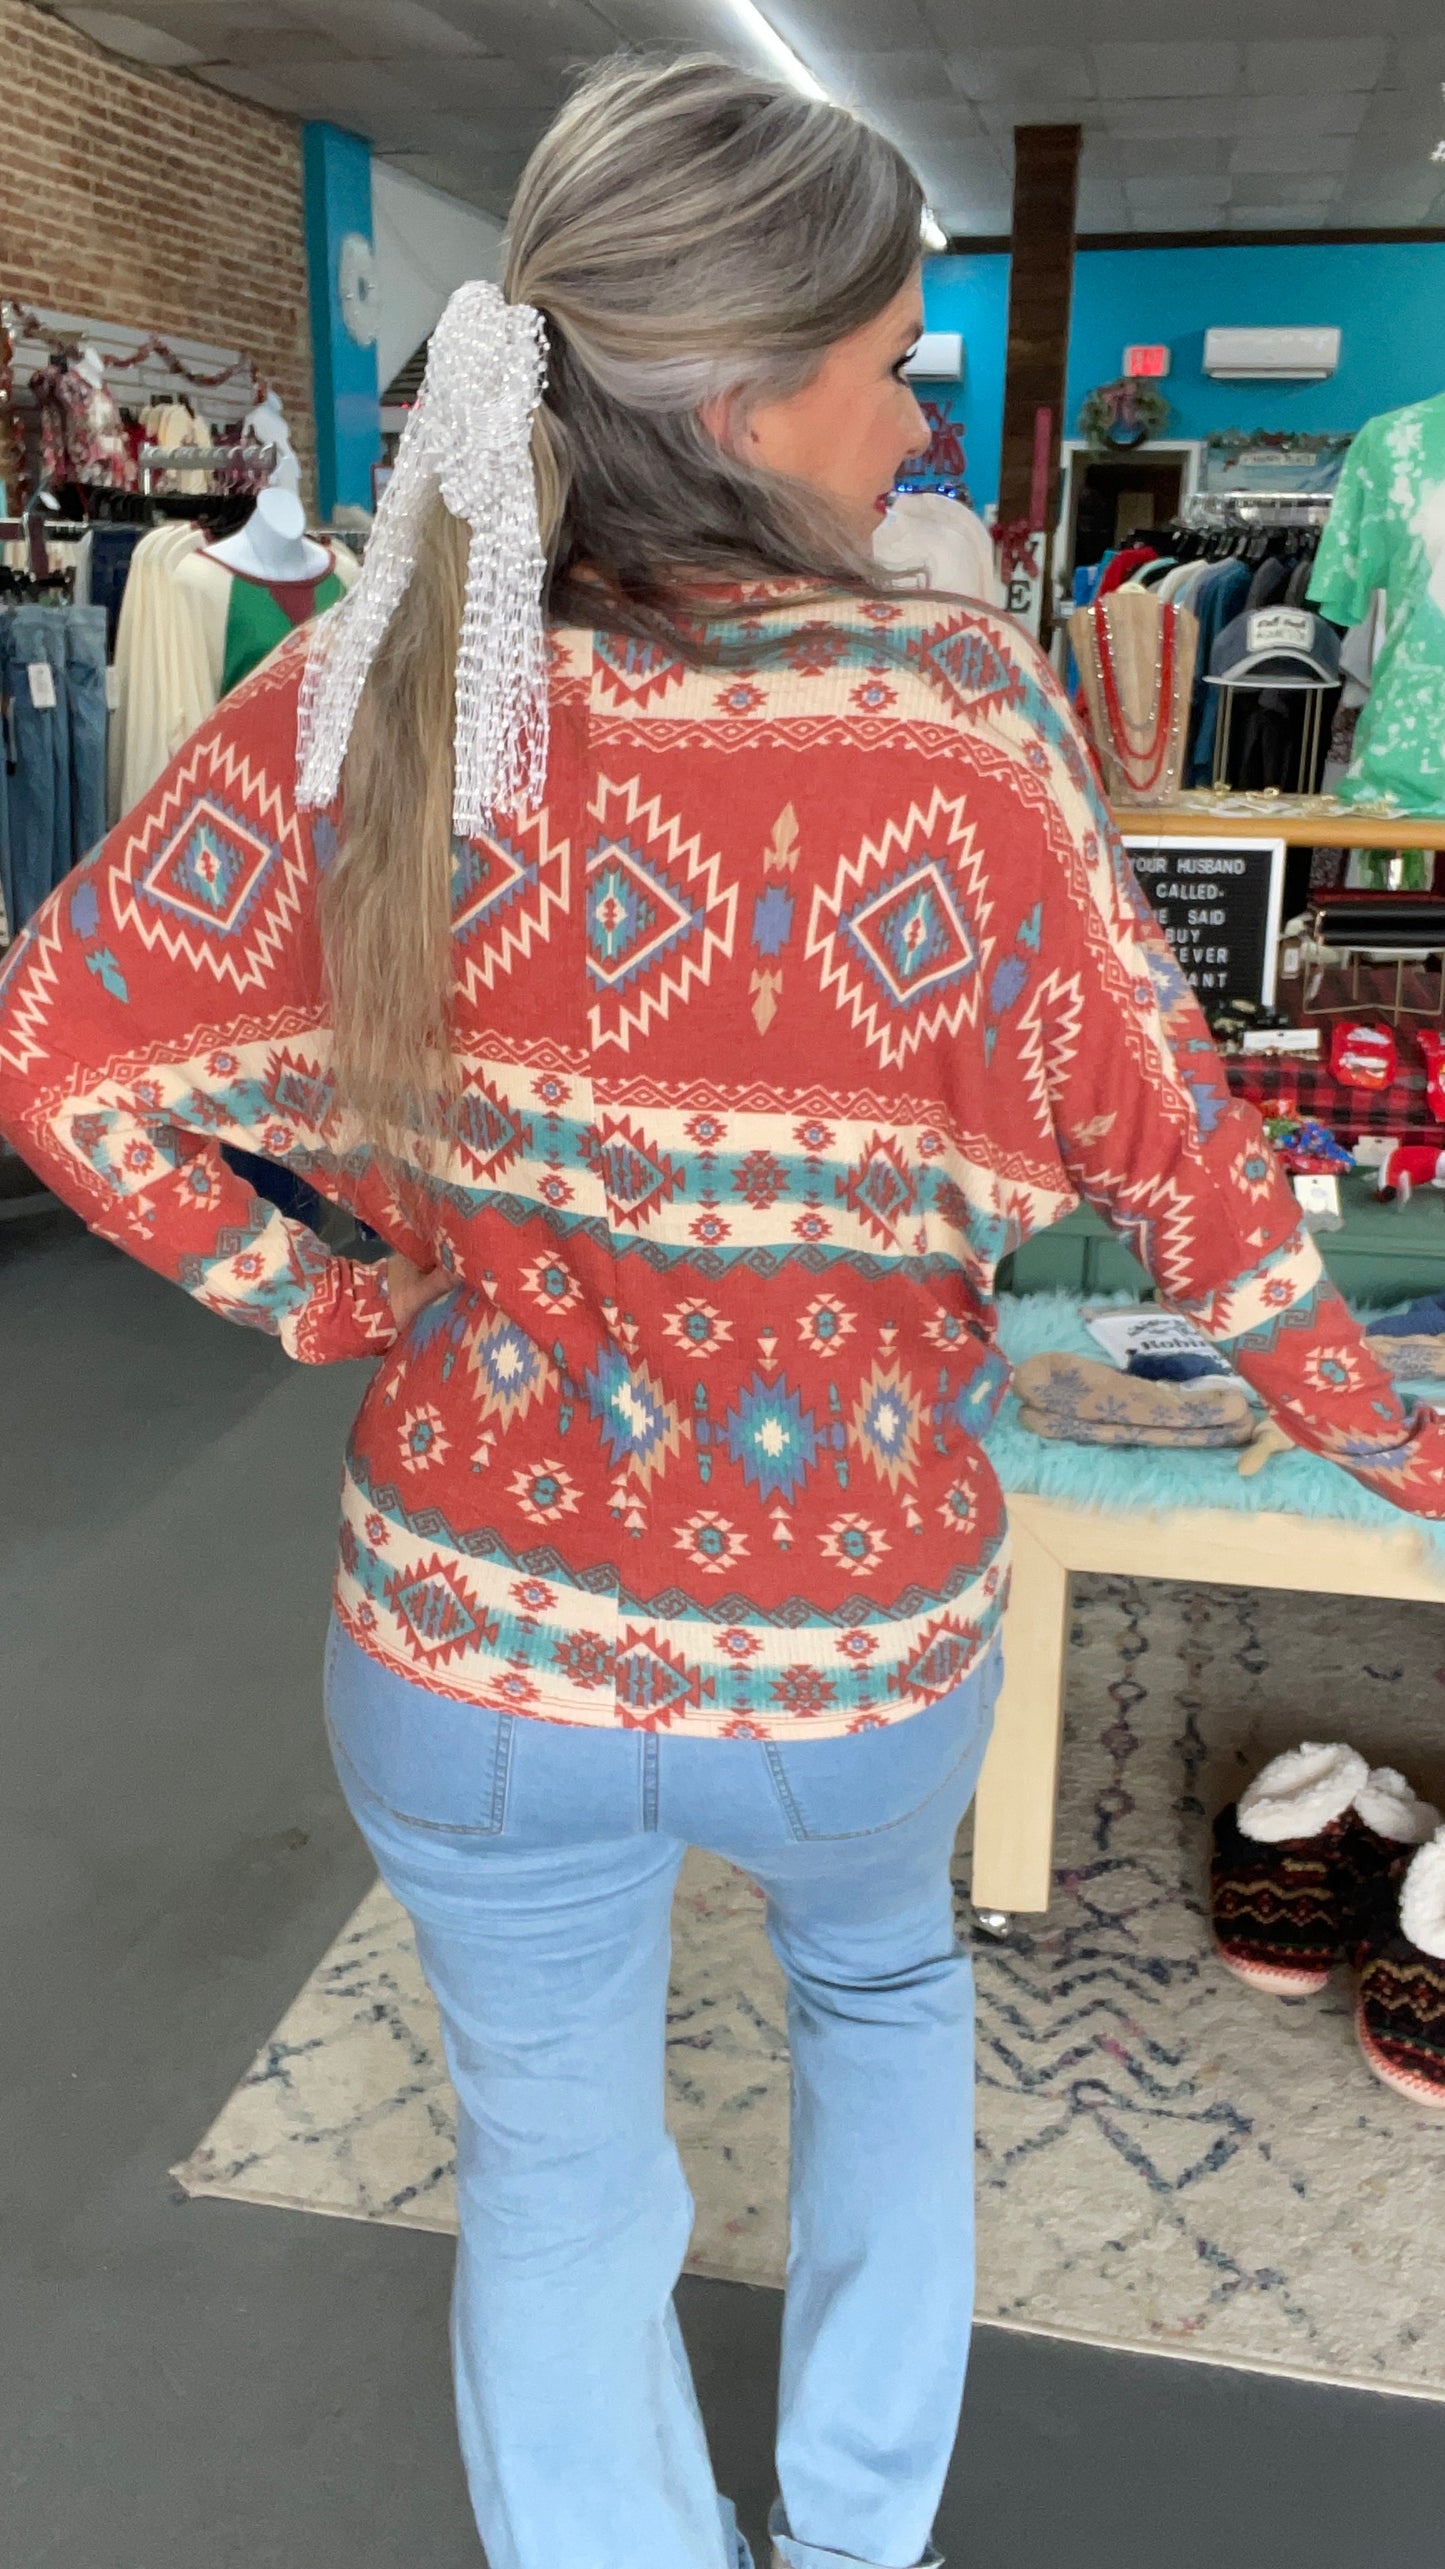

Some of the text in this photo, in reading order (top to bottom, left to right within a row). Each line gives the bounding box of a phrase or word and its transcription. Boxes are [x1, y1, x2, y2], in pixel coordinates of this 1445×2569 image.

[1177, 858, 1246, 875] HUSBAND
[1187, 909, 1226, 926] SAID
[1165, 927, 1200, 944] BUY
[1170, 946, 1229, 964] EVER
[1185, 972, 1228, 988] ANT
